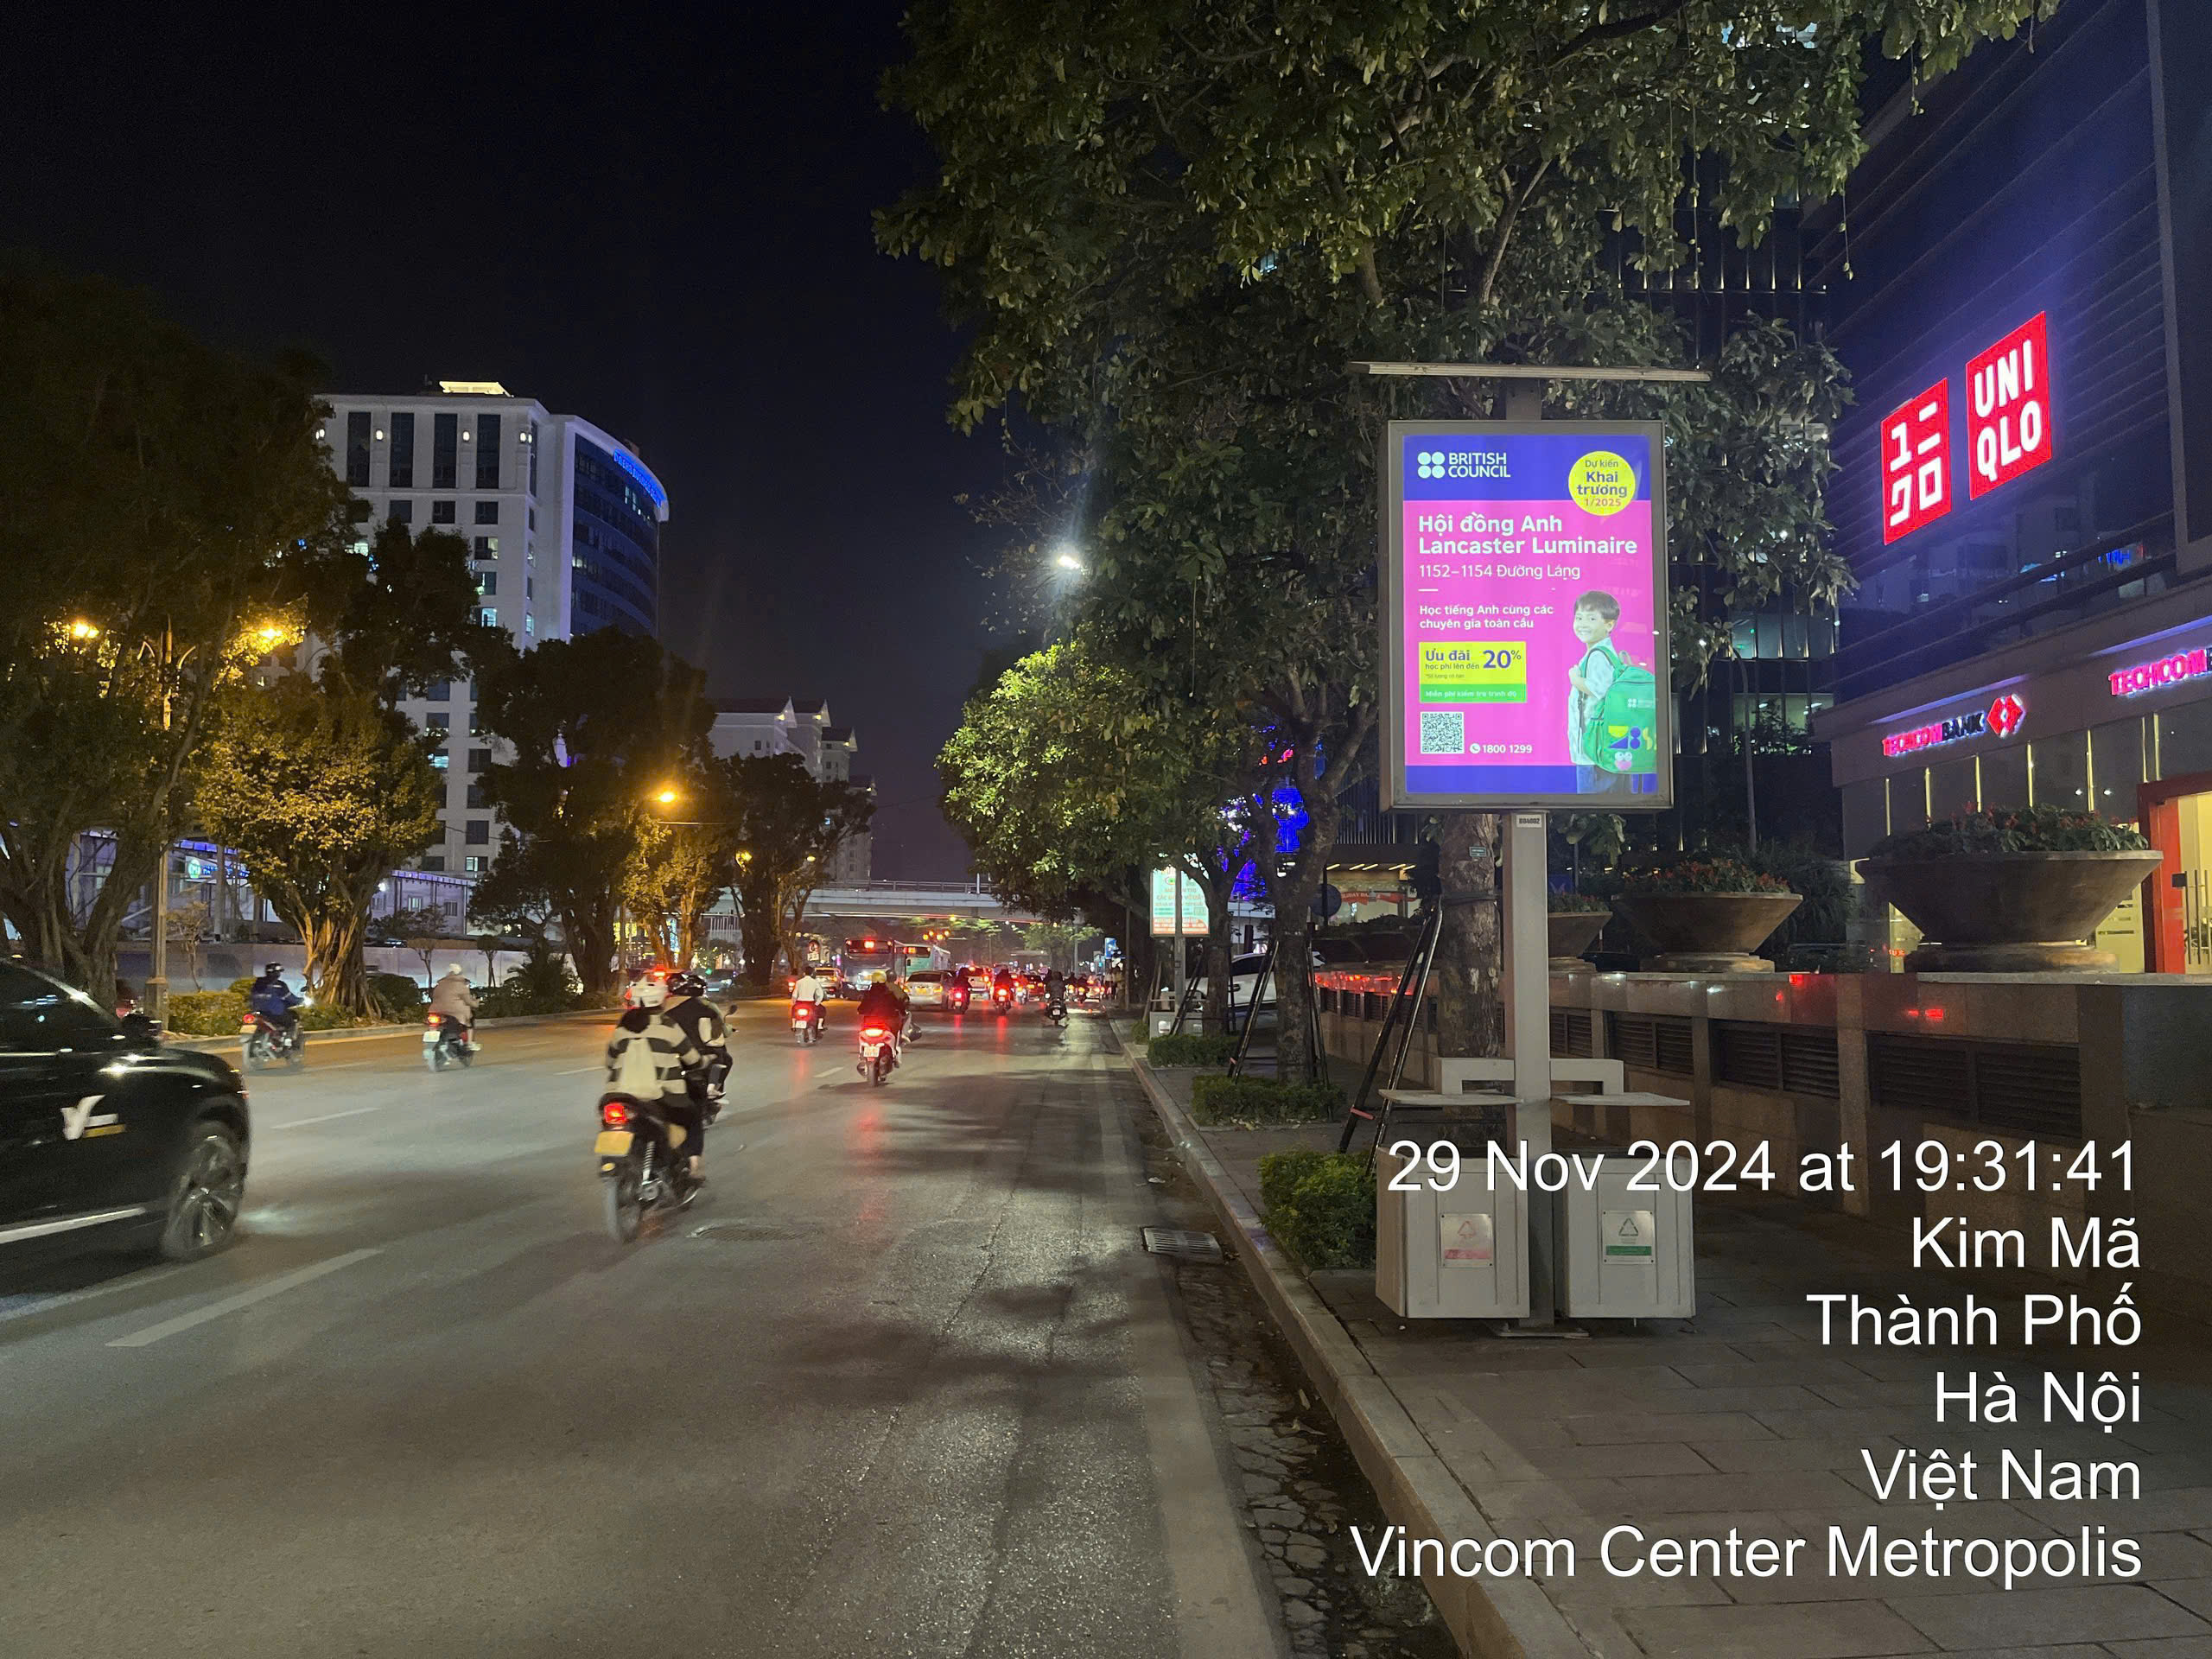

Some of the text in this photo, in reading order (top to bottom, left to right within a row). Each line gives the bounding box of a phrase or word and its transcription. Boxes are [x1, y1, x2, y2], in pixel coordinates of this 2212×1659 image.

[1974, 339, 2035, 418] UNI
[1976, 399, 2043, 482] QLO
[1448, 452, 1507, 465] BRITISH
[1447, 464, 1511, 478] COUNCIL
[1586, 471, 1618, 483] Khai
[1577, 484, 1628, 499] trương
[1585, 498, 1622, 507] 1/2025
[1418, 511, 1563, 537] Hội đồng Anh
[1419, 535, 1638, 555] Lancaster Luminaire
[1496, 564, 1544, 580] Đường
[1547, 564, 1581, 580] Láng
[1419, 605, 1442, 616] Học
[1444, 604, 1474, 617] tiếng
[1477, 605, 1499, 615] Anh
[1533, 604, 1554, 615] các
[1419, 618, 1461, 631] chuyên
[1463, 618, 1482, 631] gia
[1484, 618, 1510, 628] toàn
[1425, 648, 1445, 662] Ưu
[1448, 649, 1471, 662] đãi
[1482, 744, 1533, 754] 1800 1299
